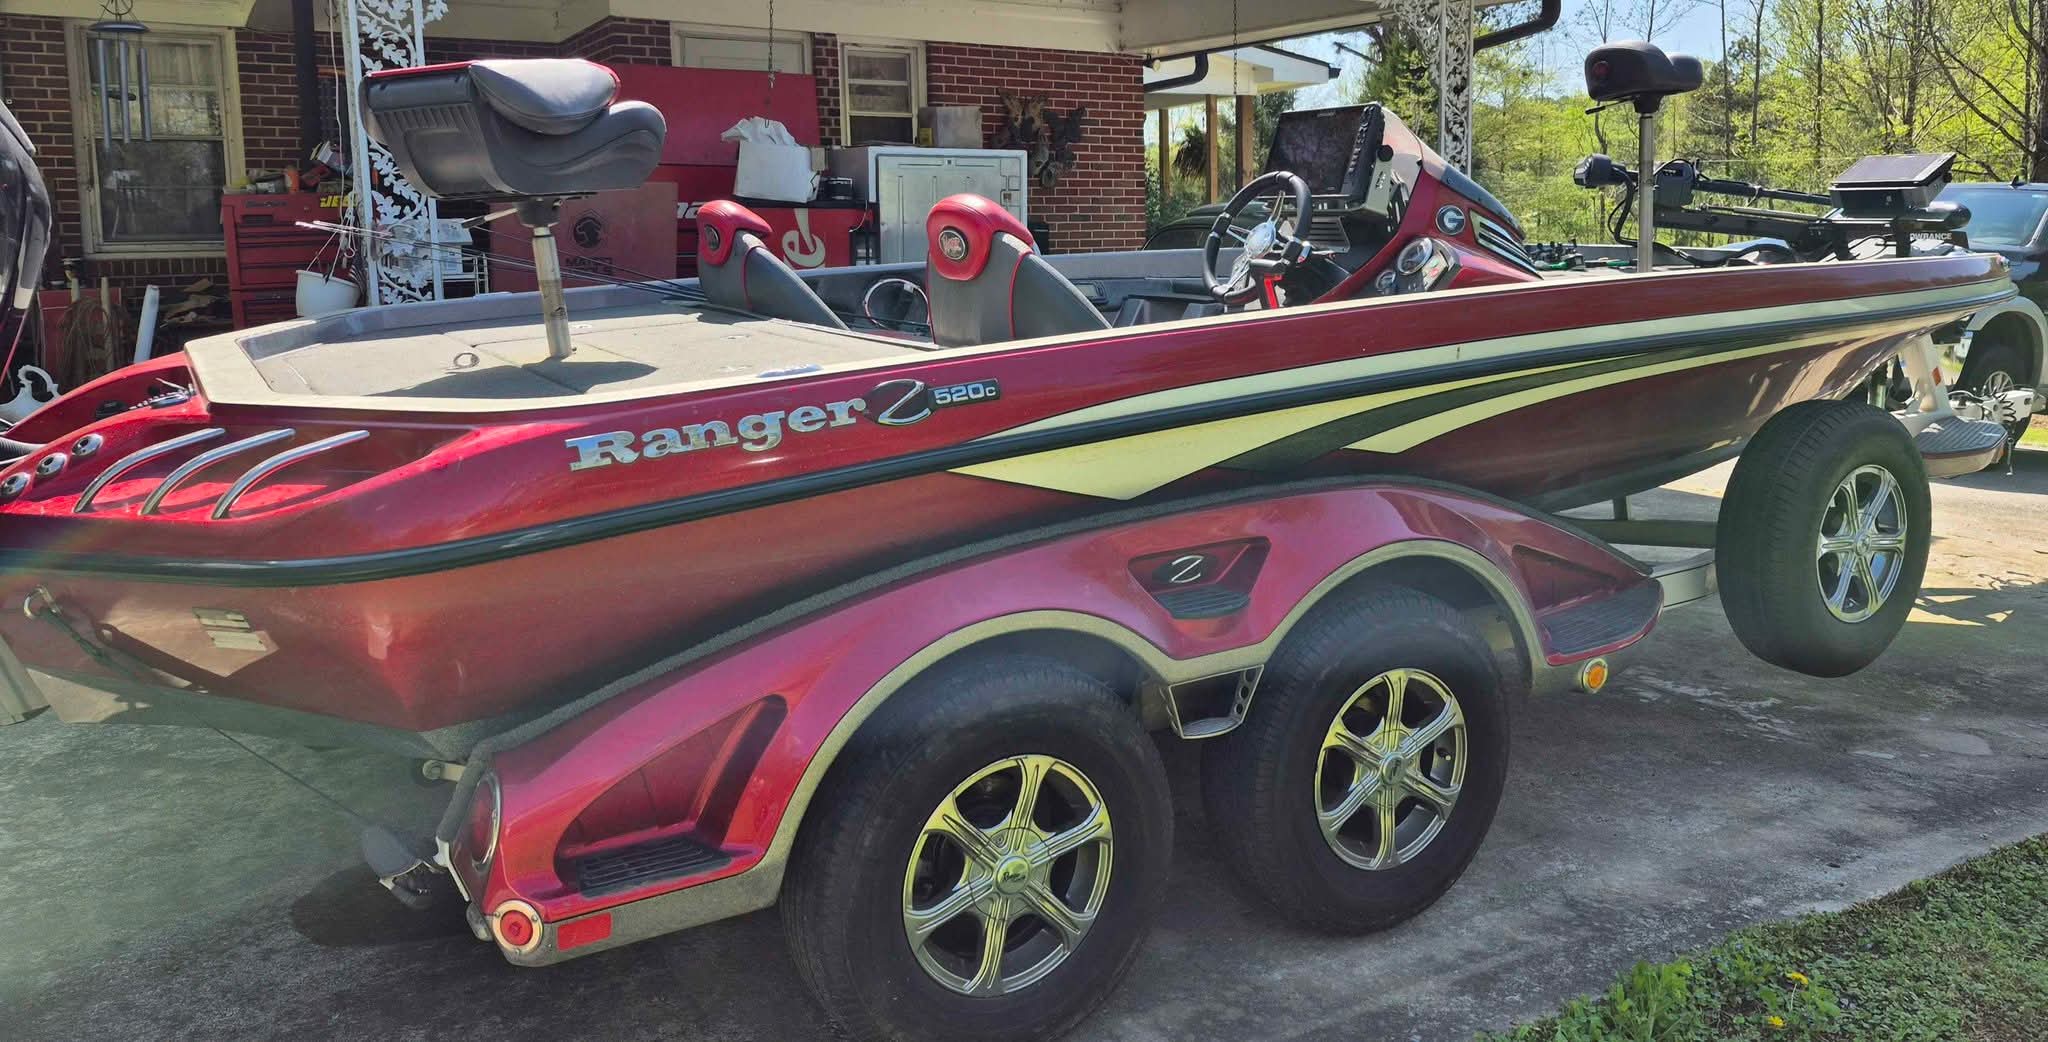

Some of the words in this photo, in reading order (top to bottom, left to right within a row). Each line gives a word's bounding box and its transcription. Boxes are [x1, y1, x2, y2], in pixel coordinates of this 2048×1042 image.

[1909, 233, 1953, 241] OWRANCE
[565, 397, 867, 471] Ranger
[934, 383, 997, 406] 520c
